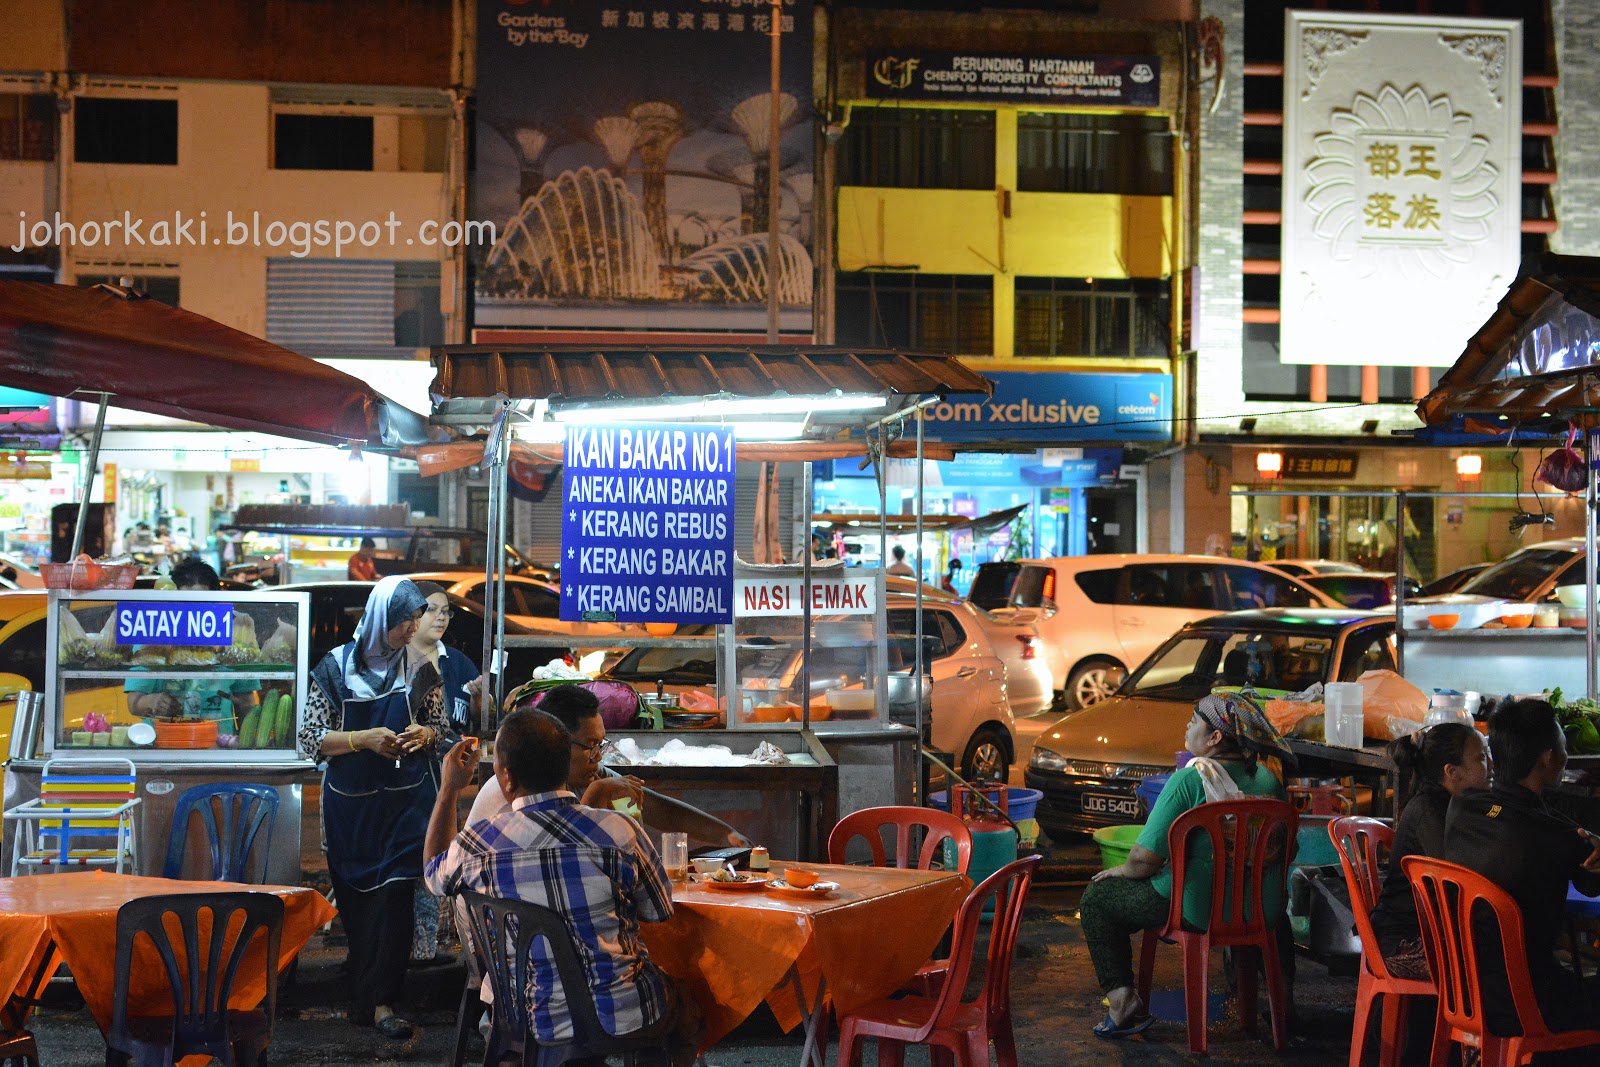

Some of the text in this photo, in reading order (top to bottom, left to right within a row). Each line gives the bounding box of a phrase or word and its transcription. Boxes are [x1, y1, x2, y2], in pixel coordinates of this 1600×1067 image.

[497, 12, 566, 28] Gardens
[924, 70, 1122, 87] CHENFOO PROPERTY CONSULTANTS
[953, 56, 1095, 75] PERUNDING HARTANAH
[988, 398, 1100, 424] xclusive
[1118, 404, 1156, 414] celcom
[567, 427, 732, 473] IKAN BAKAR NO.1
[569, 475, 728, 506] ANEKA IKAN BAKAR
[581, 509, 727, 540] KERANG REBUS
[579, 546, 727, 577] KERANG BAKAR
[577, 584, 728, 614] KERANG SAMBAL
[744, 585, 791, 611] NASI
[119, 609, 232, 639] SATAY NO.1
[1084, 797, 1106, 812] JDG
